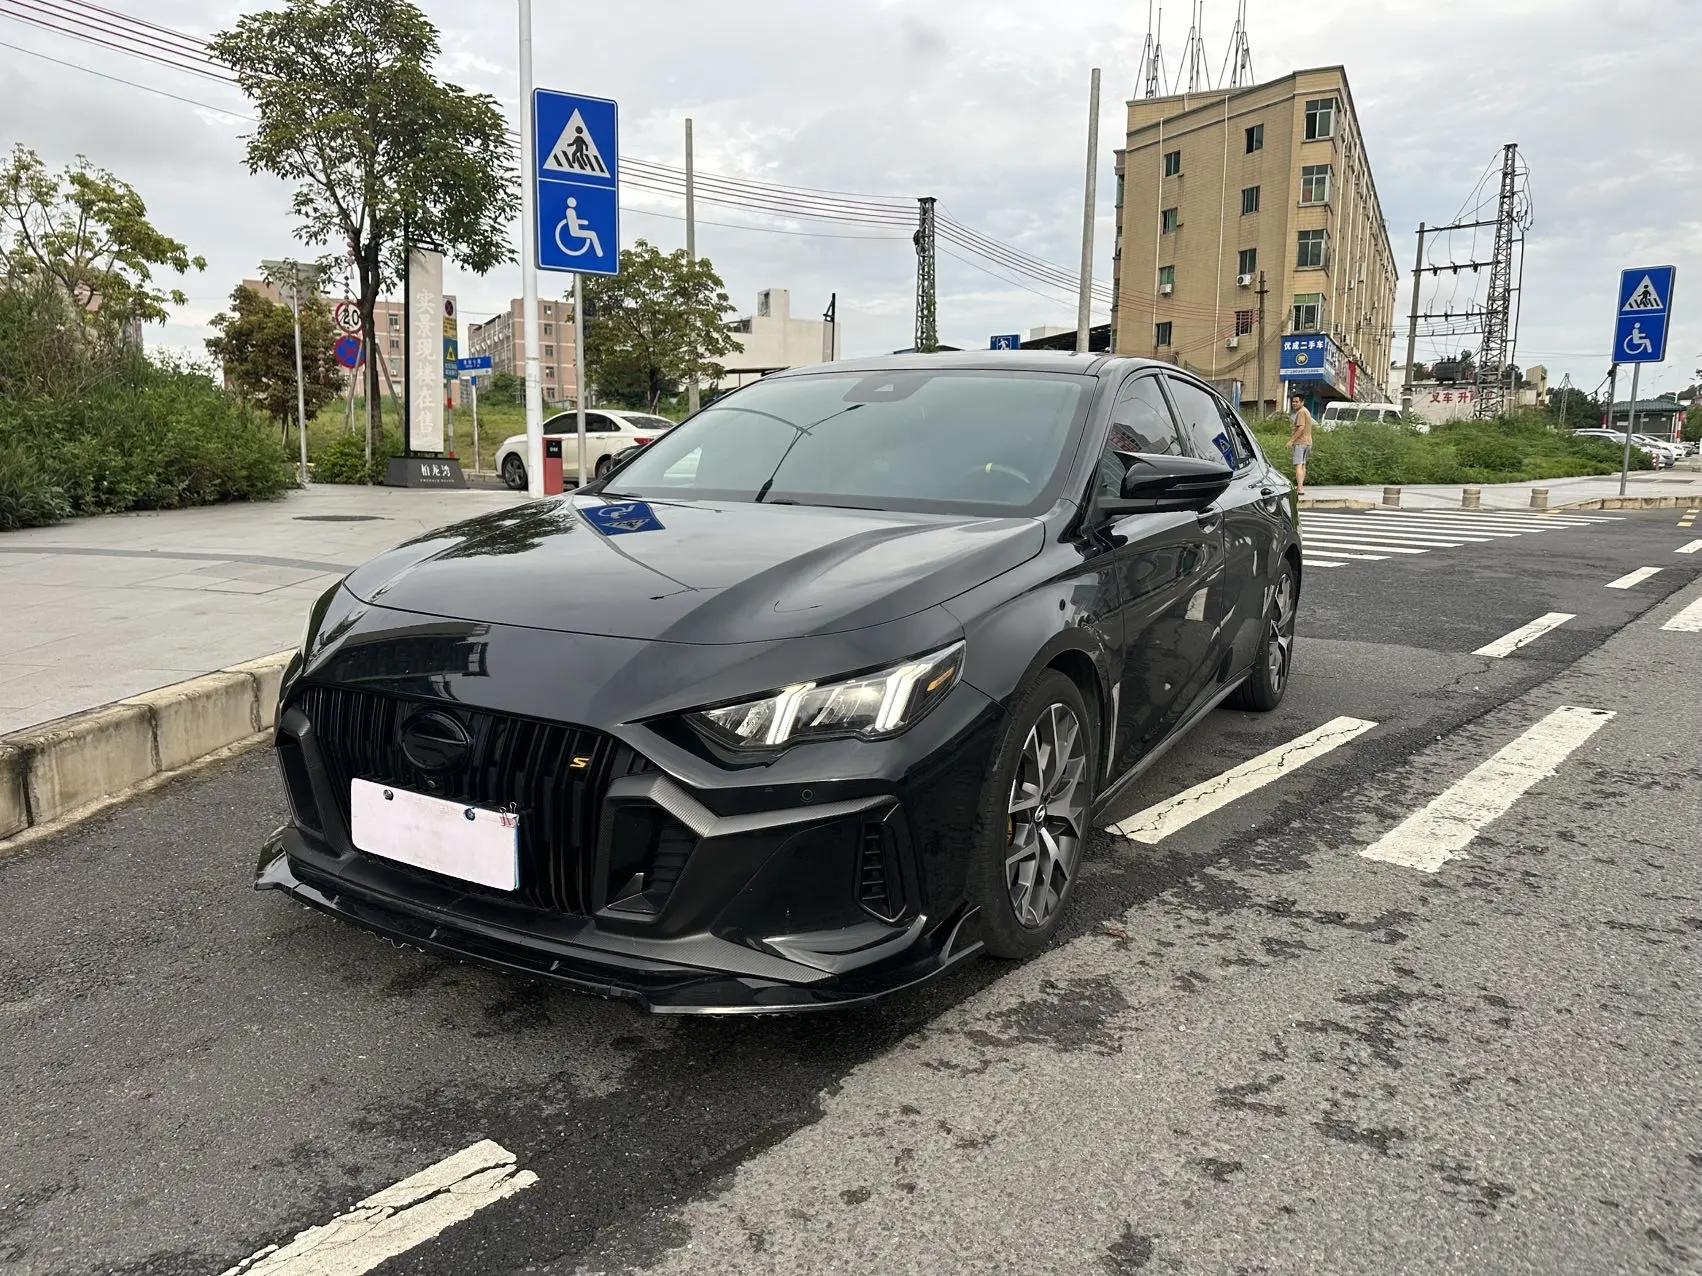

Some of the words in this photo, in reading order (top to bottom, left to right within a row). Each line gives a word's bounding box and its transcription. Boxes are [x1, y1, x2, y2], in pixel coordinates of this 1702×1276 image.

[343, 309, 359, 326] 20
[414, 287, 436, 434] 实景现楼在售
[569, 757, 590, 768] S
